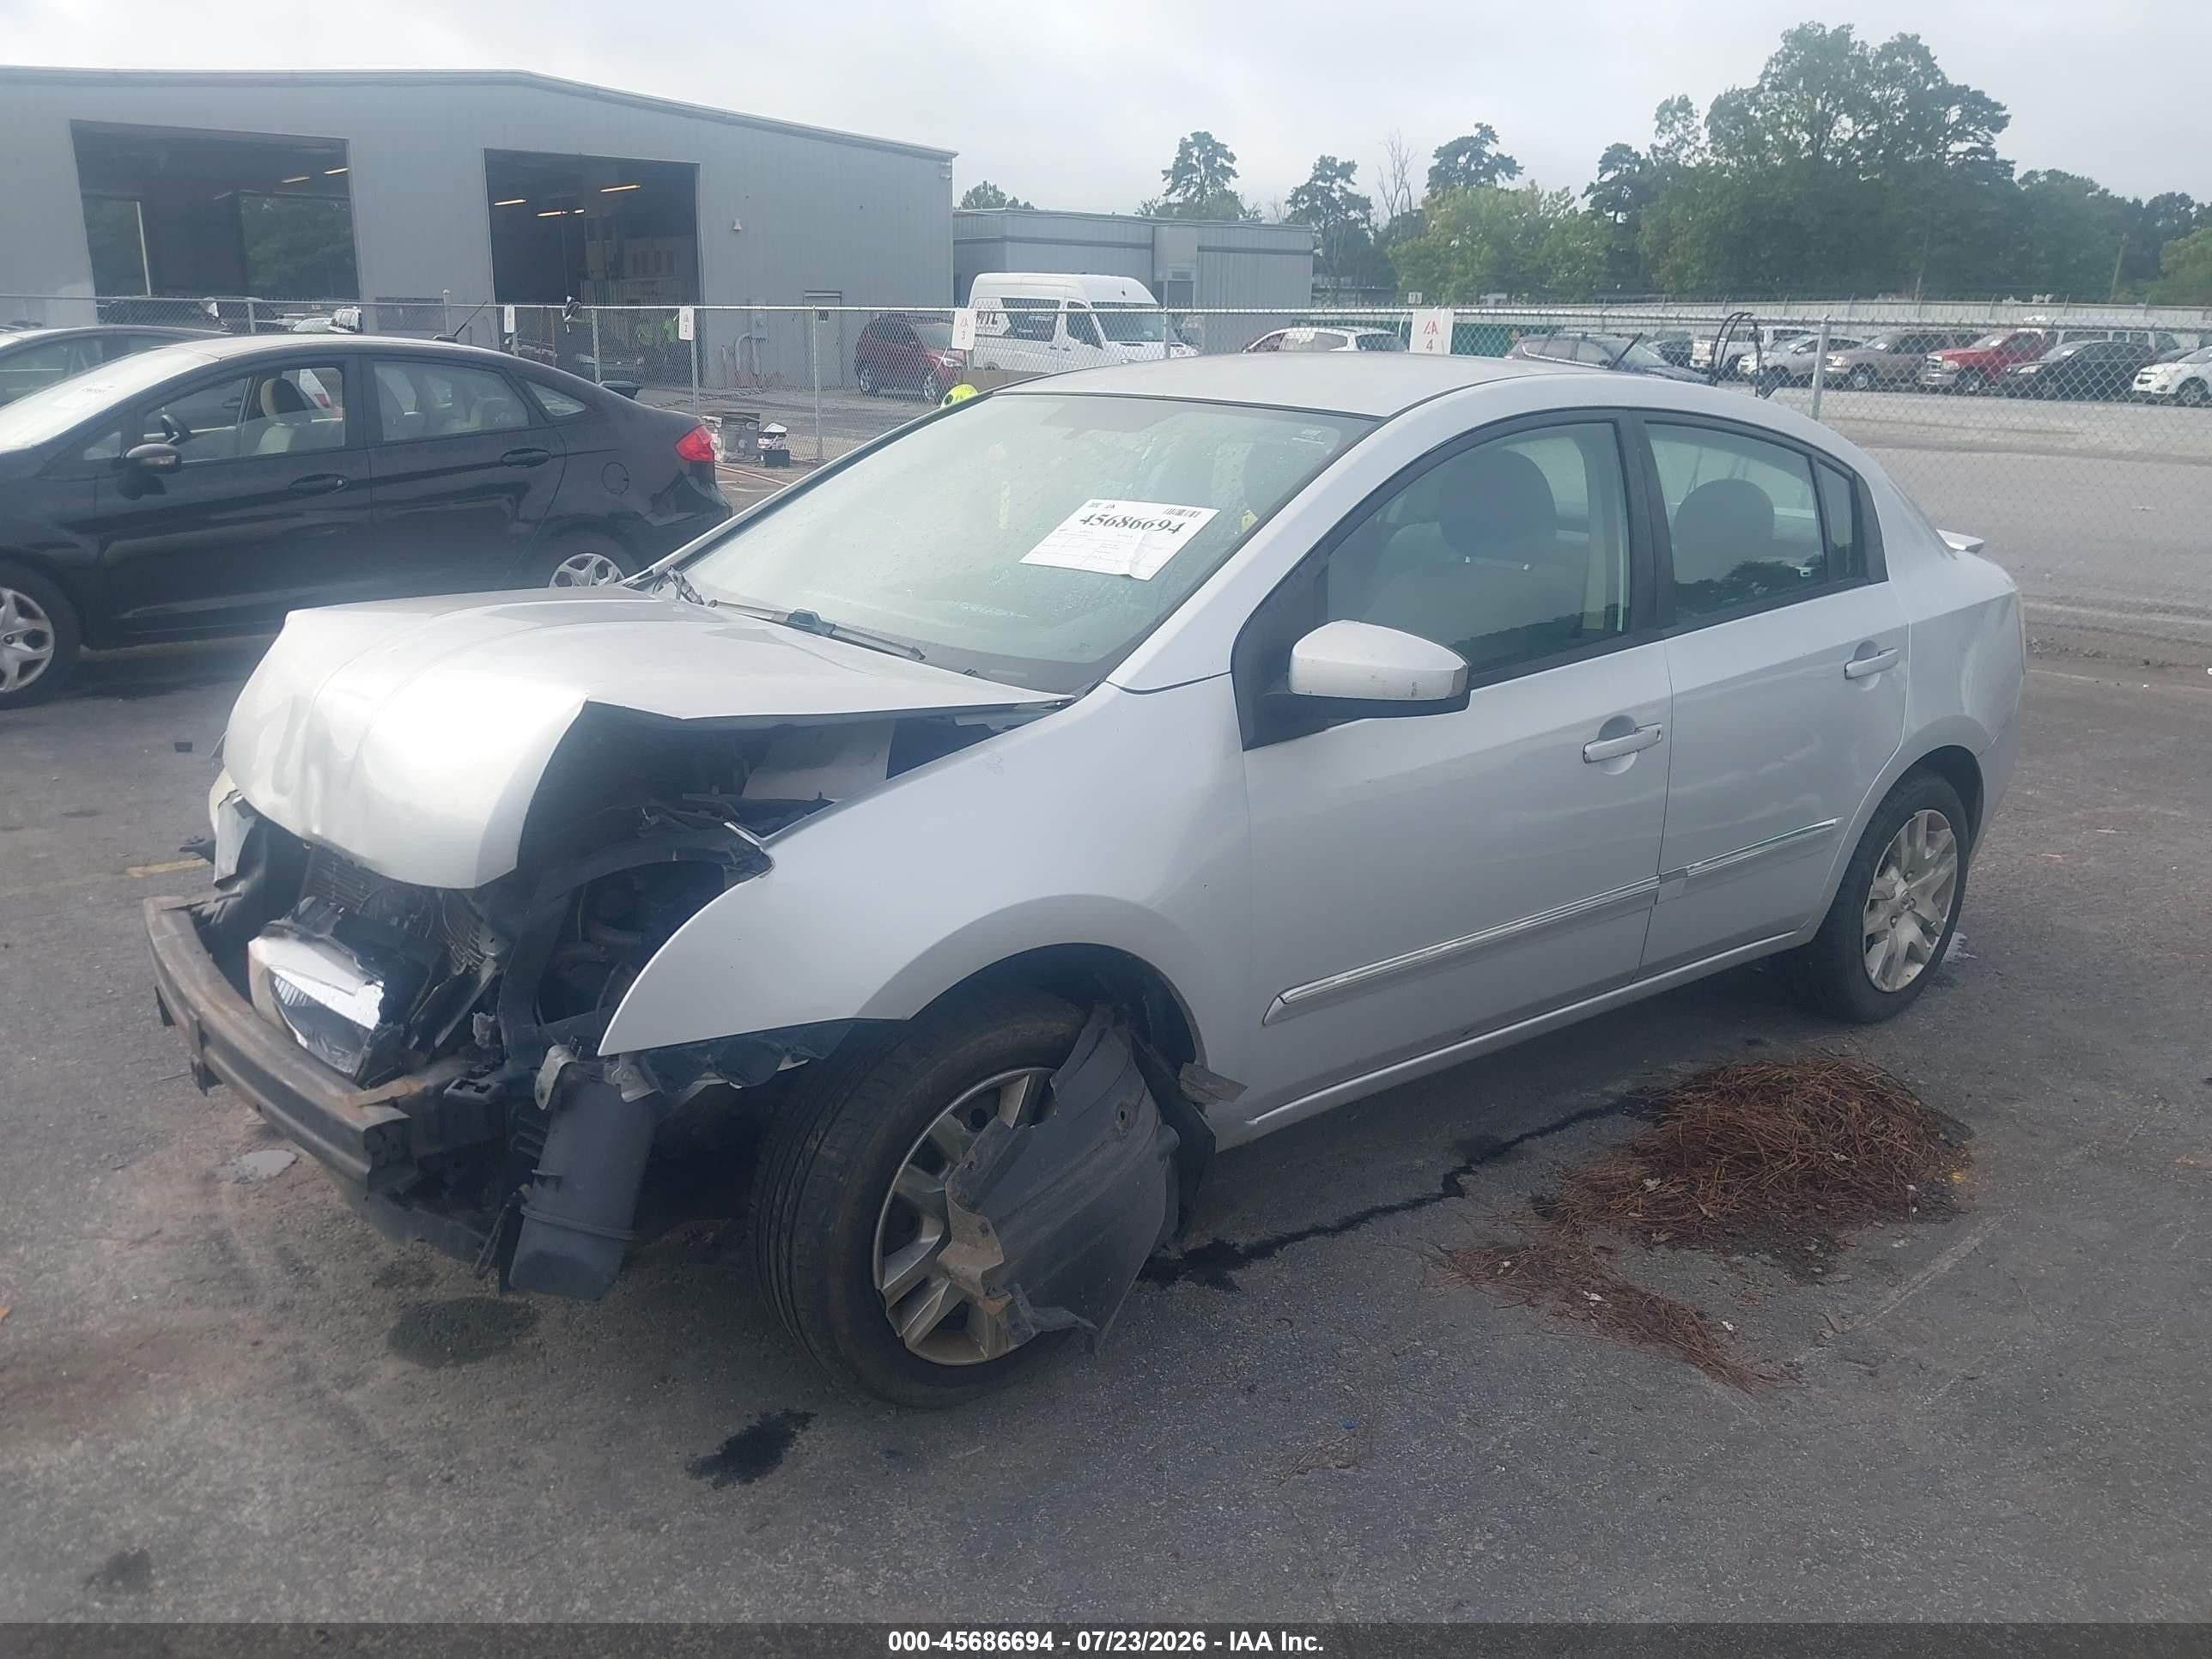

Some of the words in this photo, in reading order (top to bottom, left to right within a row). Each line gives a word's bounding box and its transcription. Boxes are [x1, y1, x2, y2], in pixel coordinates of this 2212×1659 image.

[961, 330, 966, 340] 3
[1426, 338, 1433, 351] 4
[1079, 513, 1186, 534] 45686694
